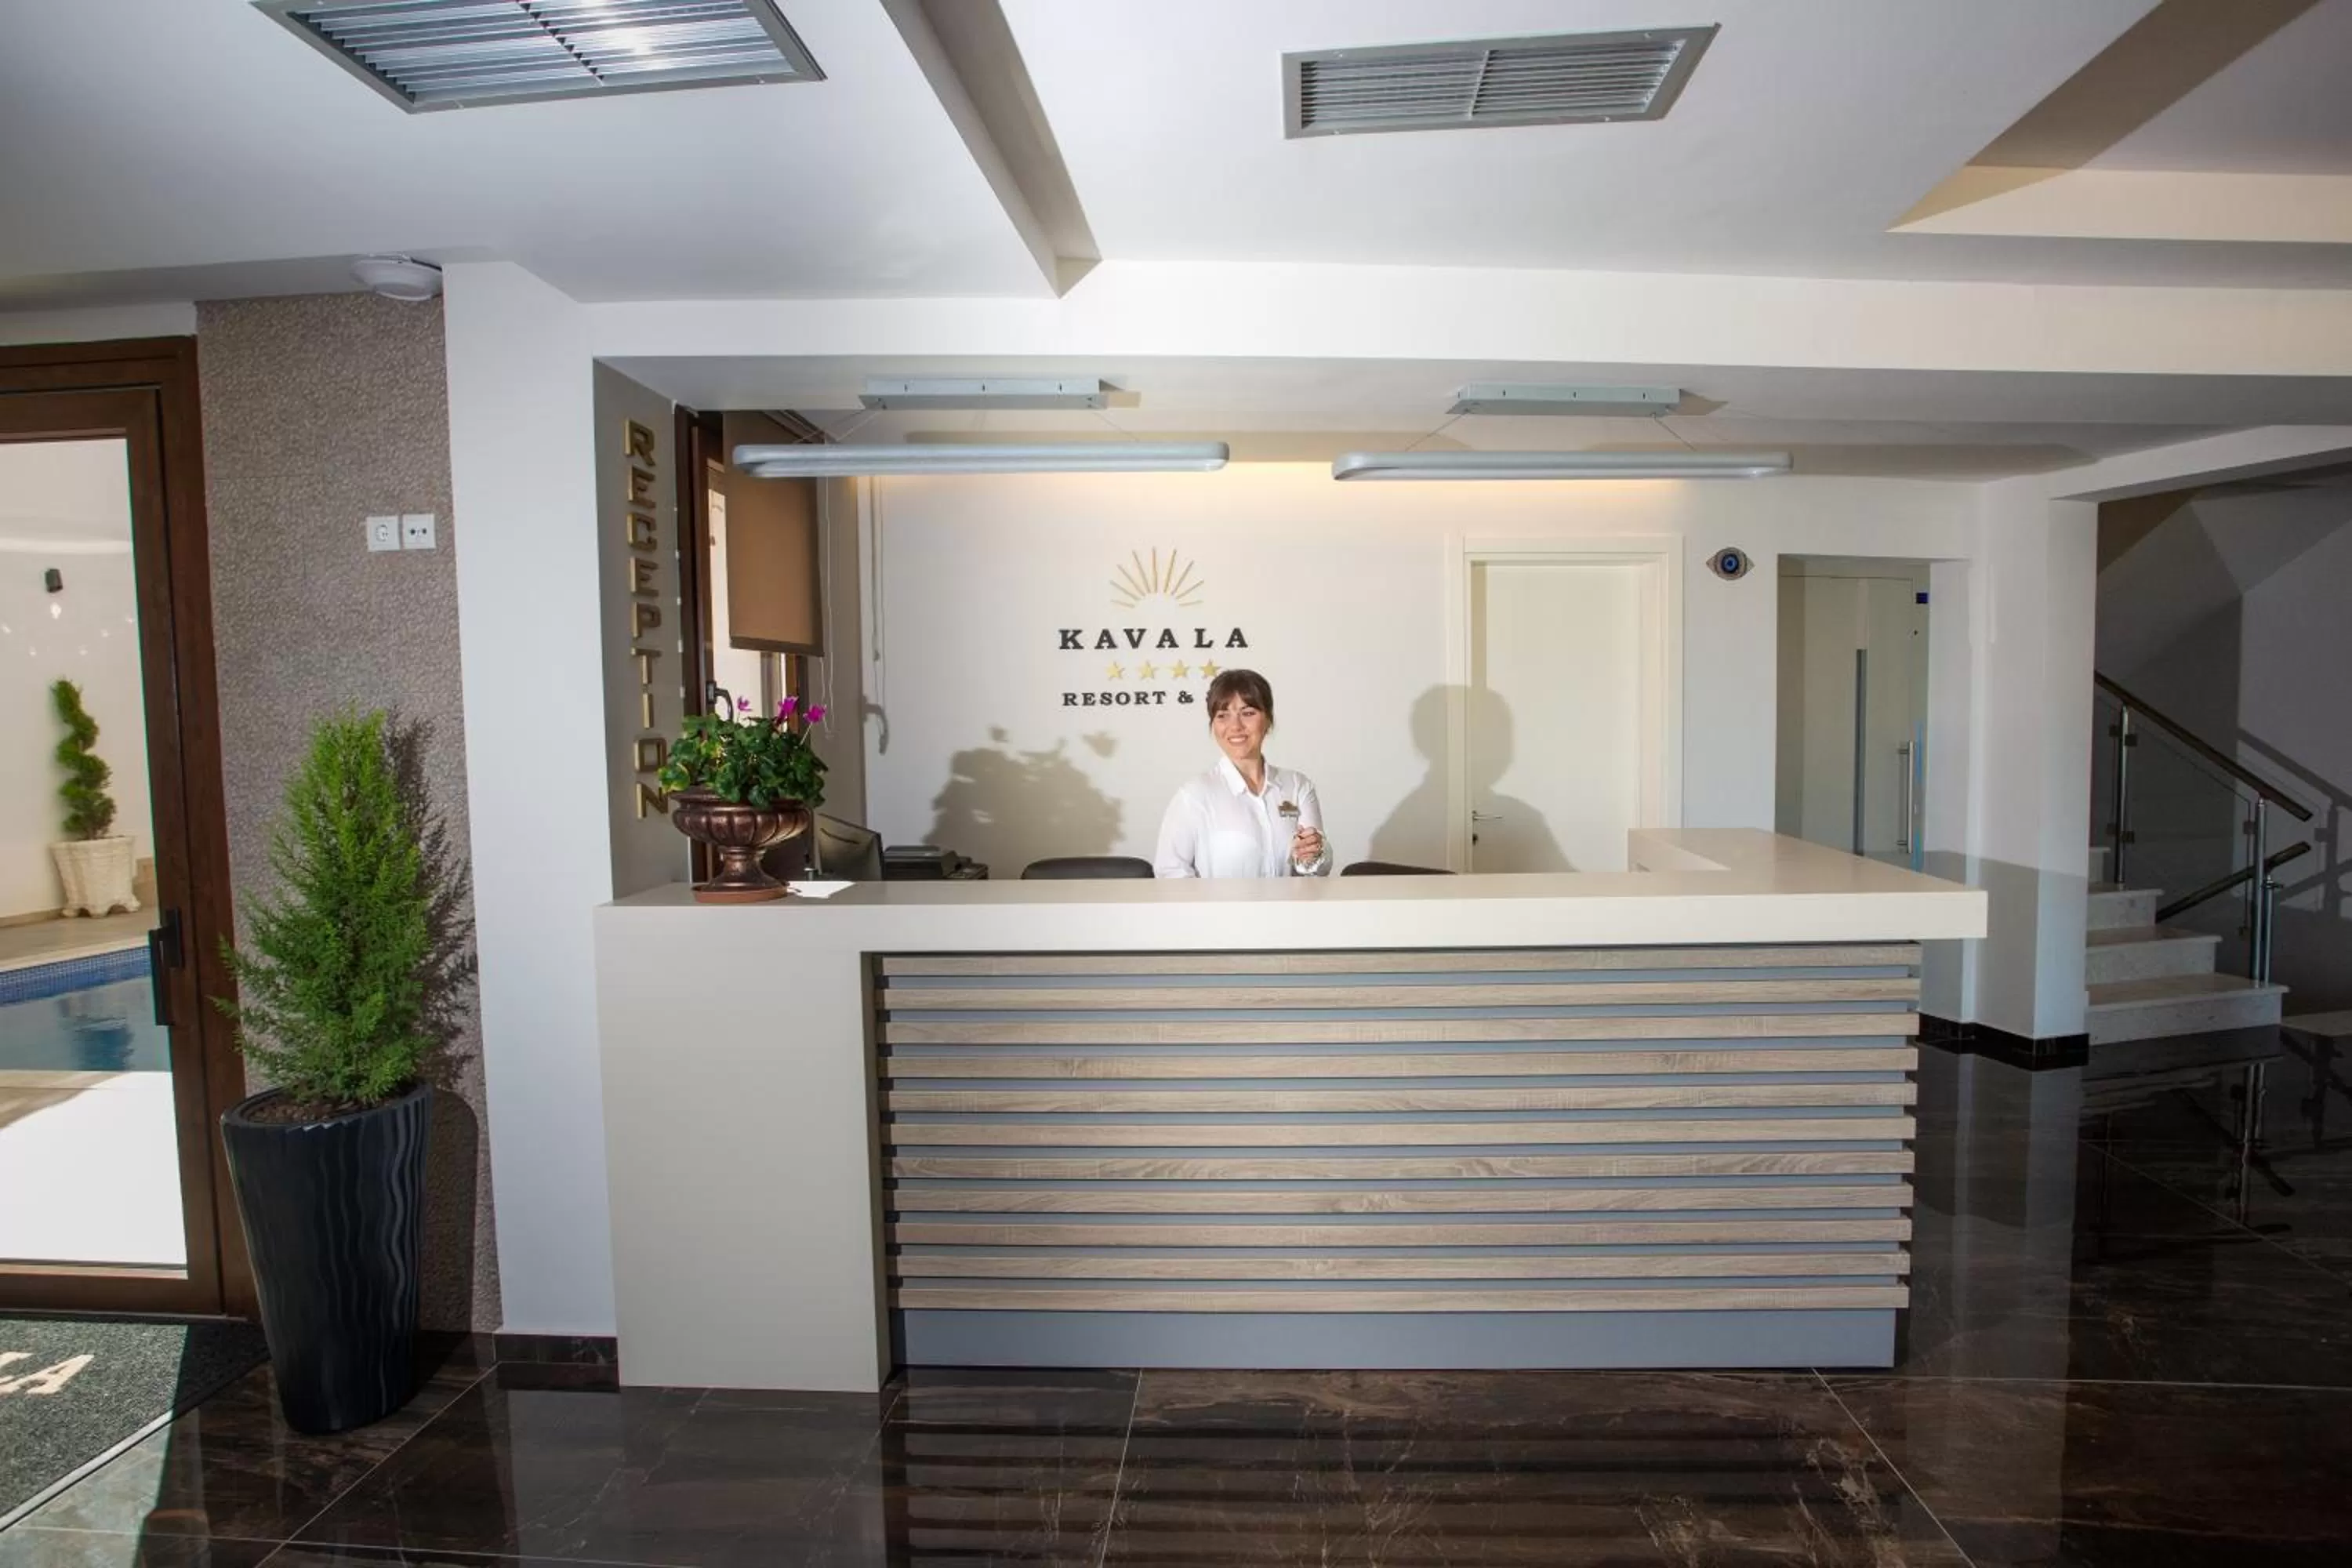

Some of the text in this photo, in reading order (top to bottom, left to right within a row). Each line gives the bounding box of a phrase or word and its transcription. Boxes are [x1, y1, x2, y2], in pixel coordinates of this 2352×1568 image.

[625, 418, 669, 819] RECEPTION
[1058, 627, 1248, 650] KAVALA
[1062, 690, 1167, 706] RESORT
[1177, 690, 1194, 704] &
